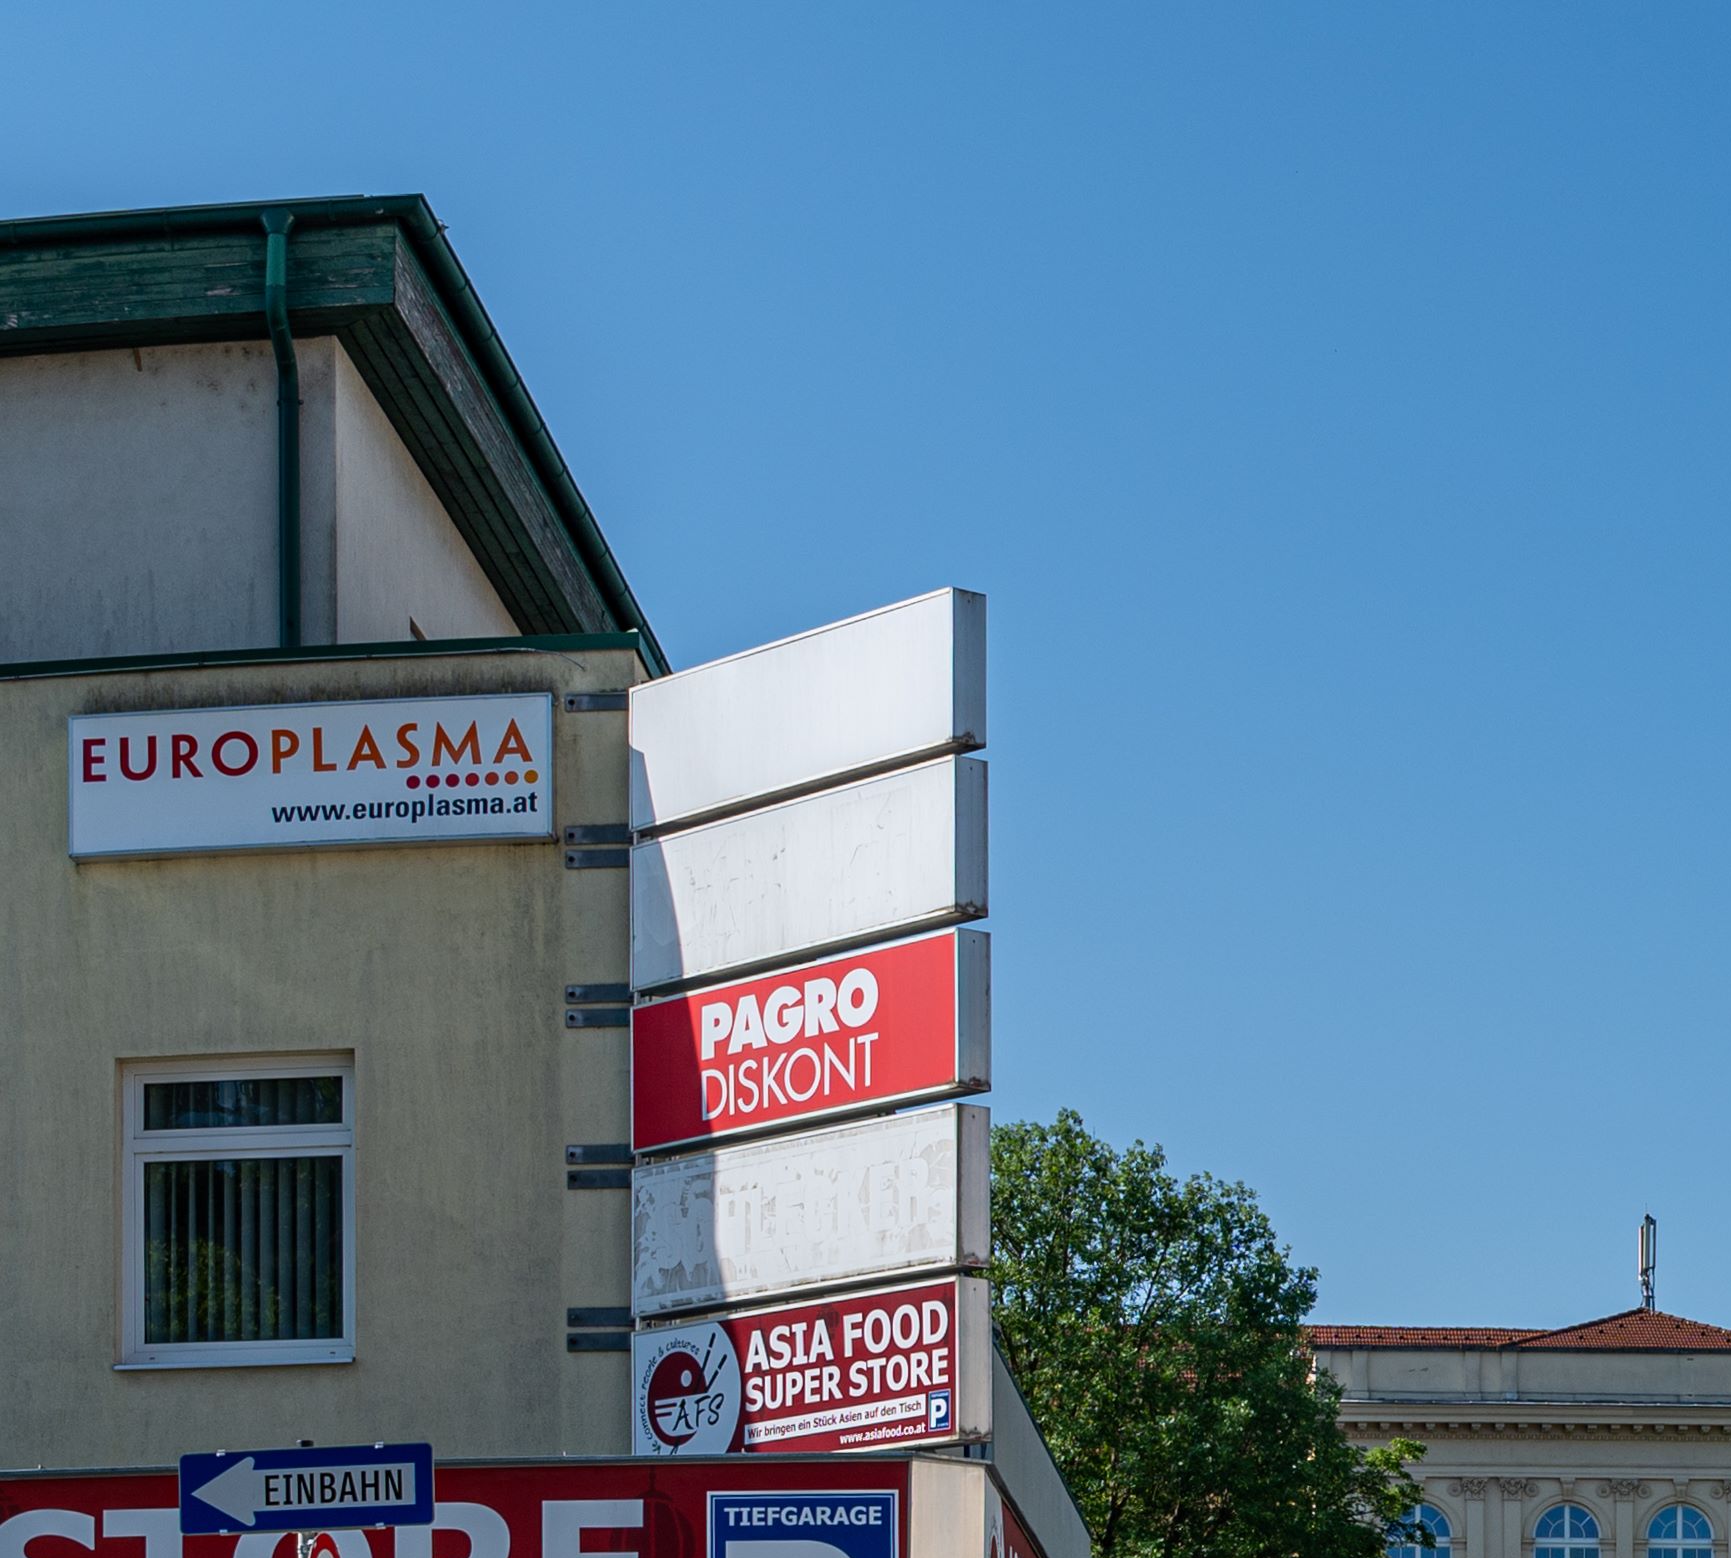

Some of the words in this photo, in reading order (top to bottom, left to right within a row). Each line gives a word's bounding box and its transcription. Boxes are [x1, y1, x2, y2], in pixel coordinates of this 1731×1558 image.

[82, 717, 533, 783] EUROPLASMA
[271, 791, 538, 824] www.europlasma.at
[701, 967, 879, 1061] PAGRO
[701, 1031, 879, 1122] DISKONT
[744, 1319, 834, 1373] ASIA
[843, 1299, 949, 1358] FOOD
[744, 1364, 843, 1413] SUPER
[849, 1346, 949, 1398] STORE
[672, 1392, 724, 1431] AFS
[747, 1425, 762, 1439] Wir
[763, 1420, 797, 1440] bringen
[798, 1417, 811, 1432] ein
[813, 1411, 838, 1430] Stück
[838, 1409, 862, 1425] Asien
[864, 1405, 880, 1420] auf
[880, 1402, 897, 1418] den
[898, 1398, 922, 1414] Tisch
[930, 1398, 947, 1428] P
[839, 1421, 926, 1445] www.asiafood.co.at
[264, 1468, 402, 1507] EINBAHN
[724, 1505, 882, 1527] TIEFGARAGE
